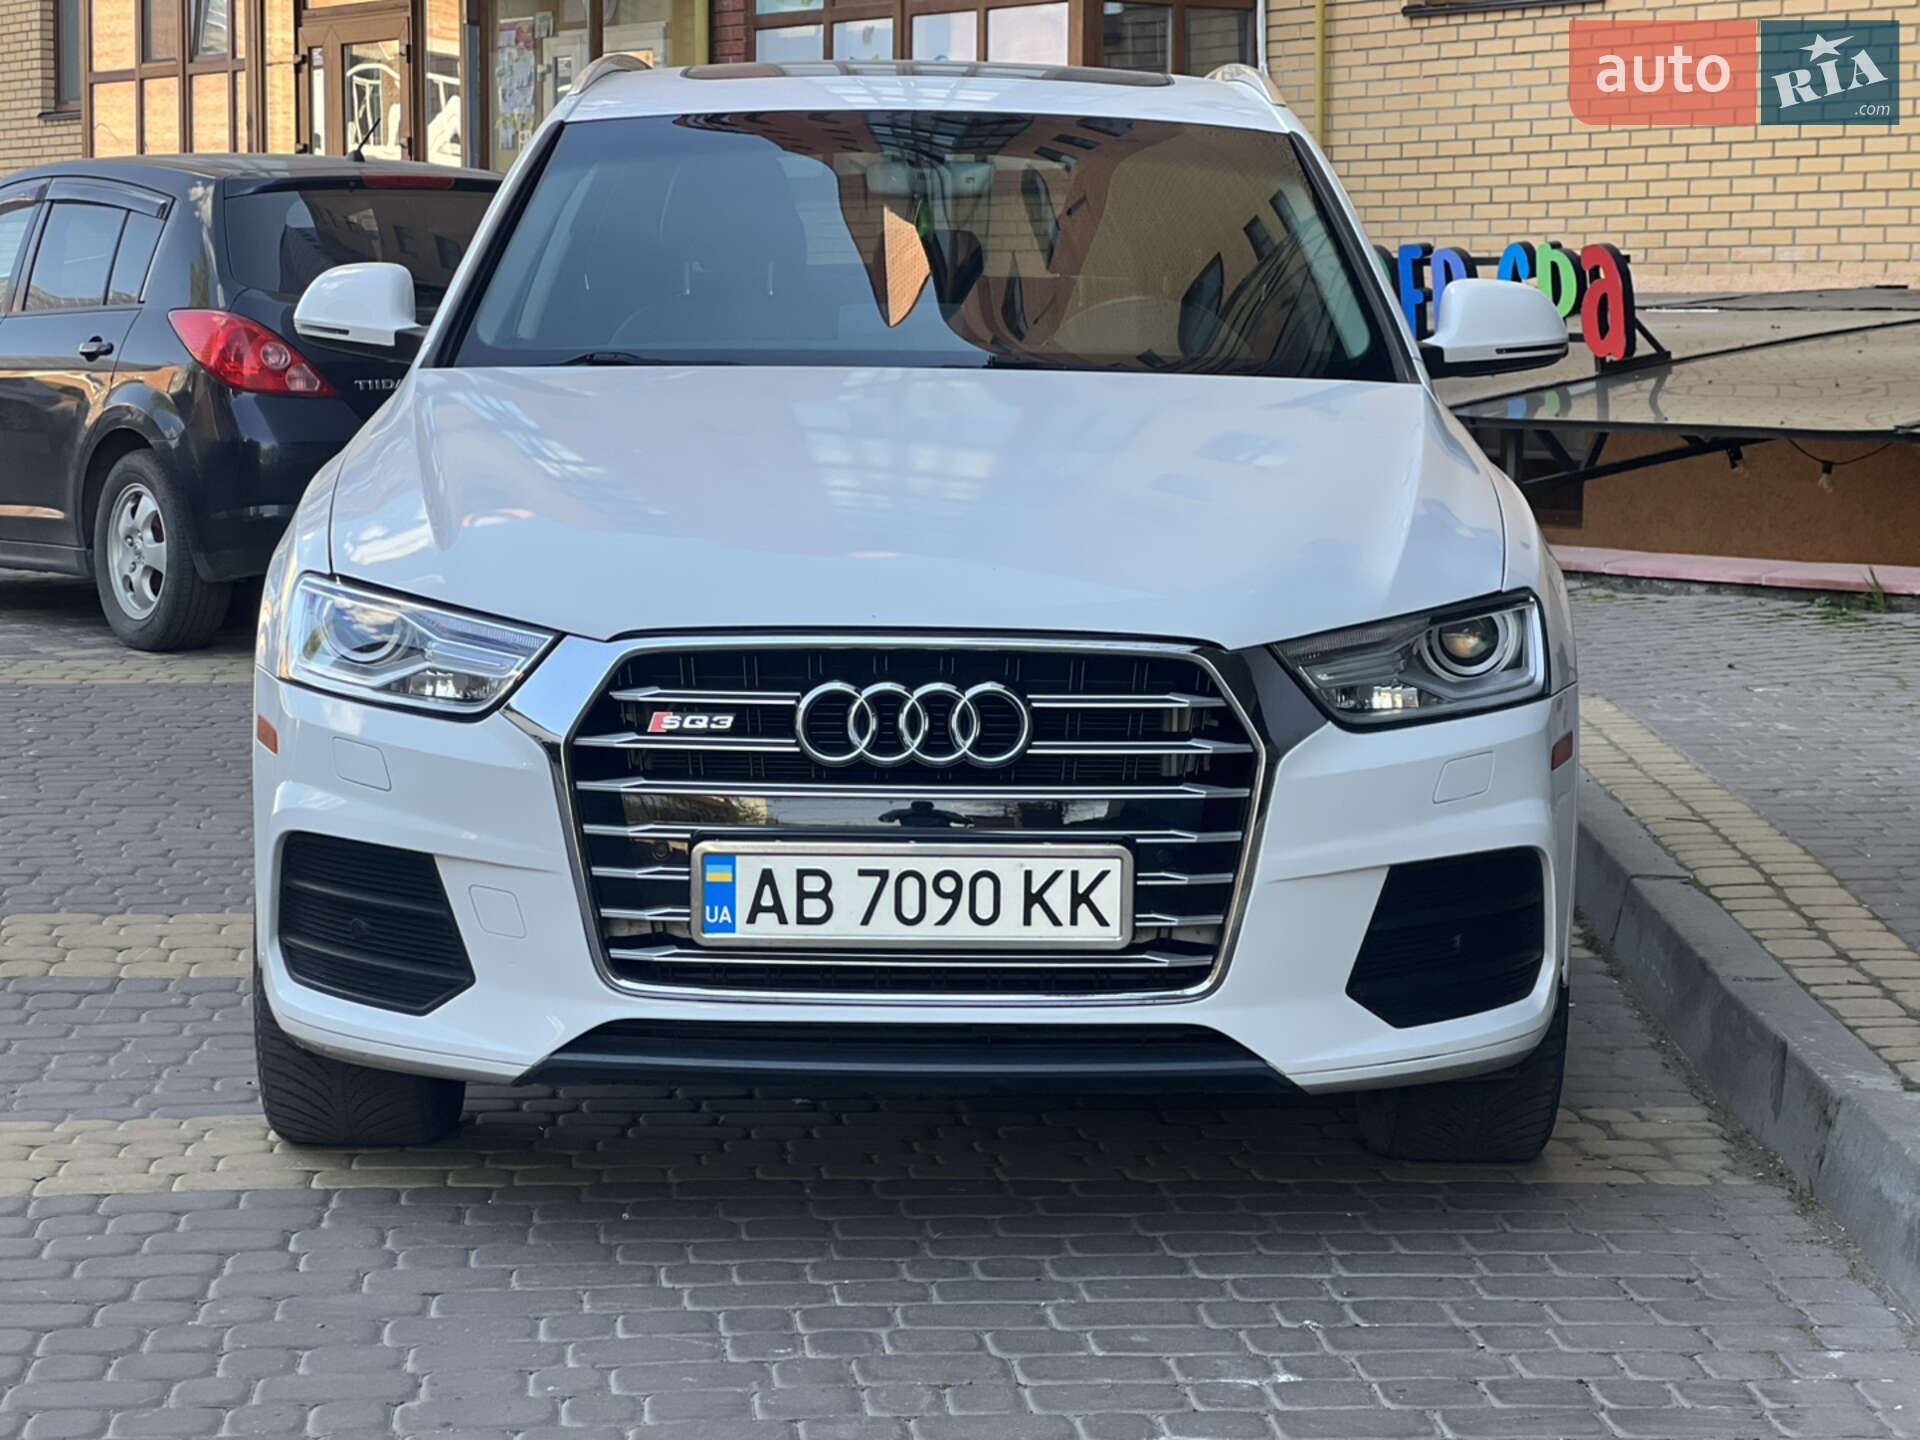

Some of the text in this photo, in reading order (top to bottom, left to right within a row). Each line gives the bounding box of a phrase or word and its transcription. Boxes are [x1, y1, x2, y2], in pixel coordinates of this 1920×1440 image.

[659, 714, 735, 730] SQ3
[745, 868, 1112, 927] AB 7090 KK
[705, 905, 732, 924] UA
